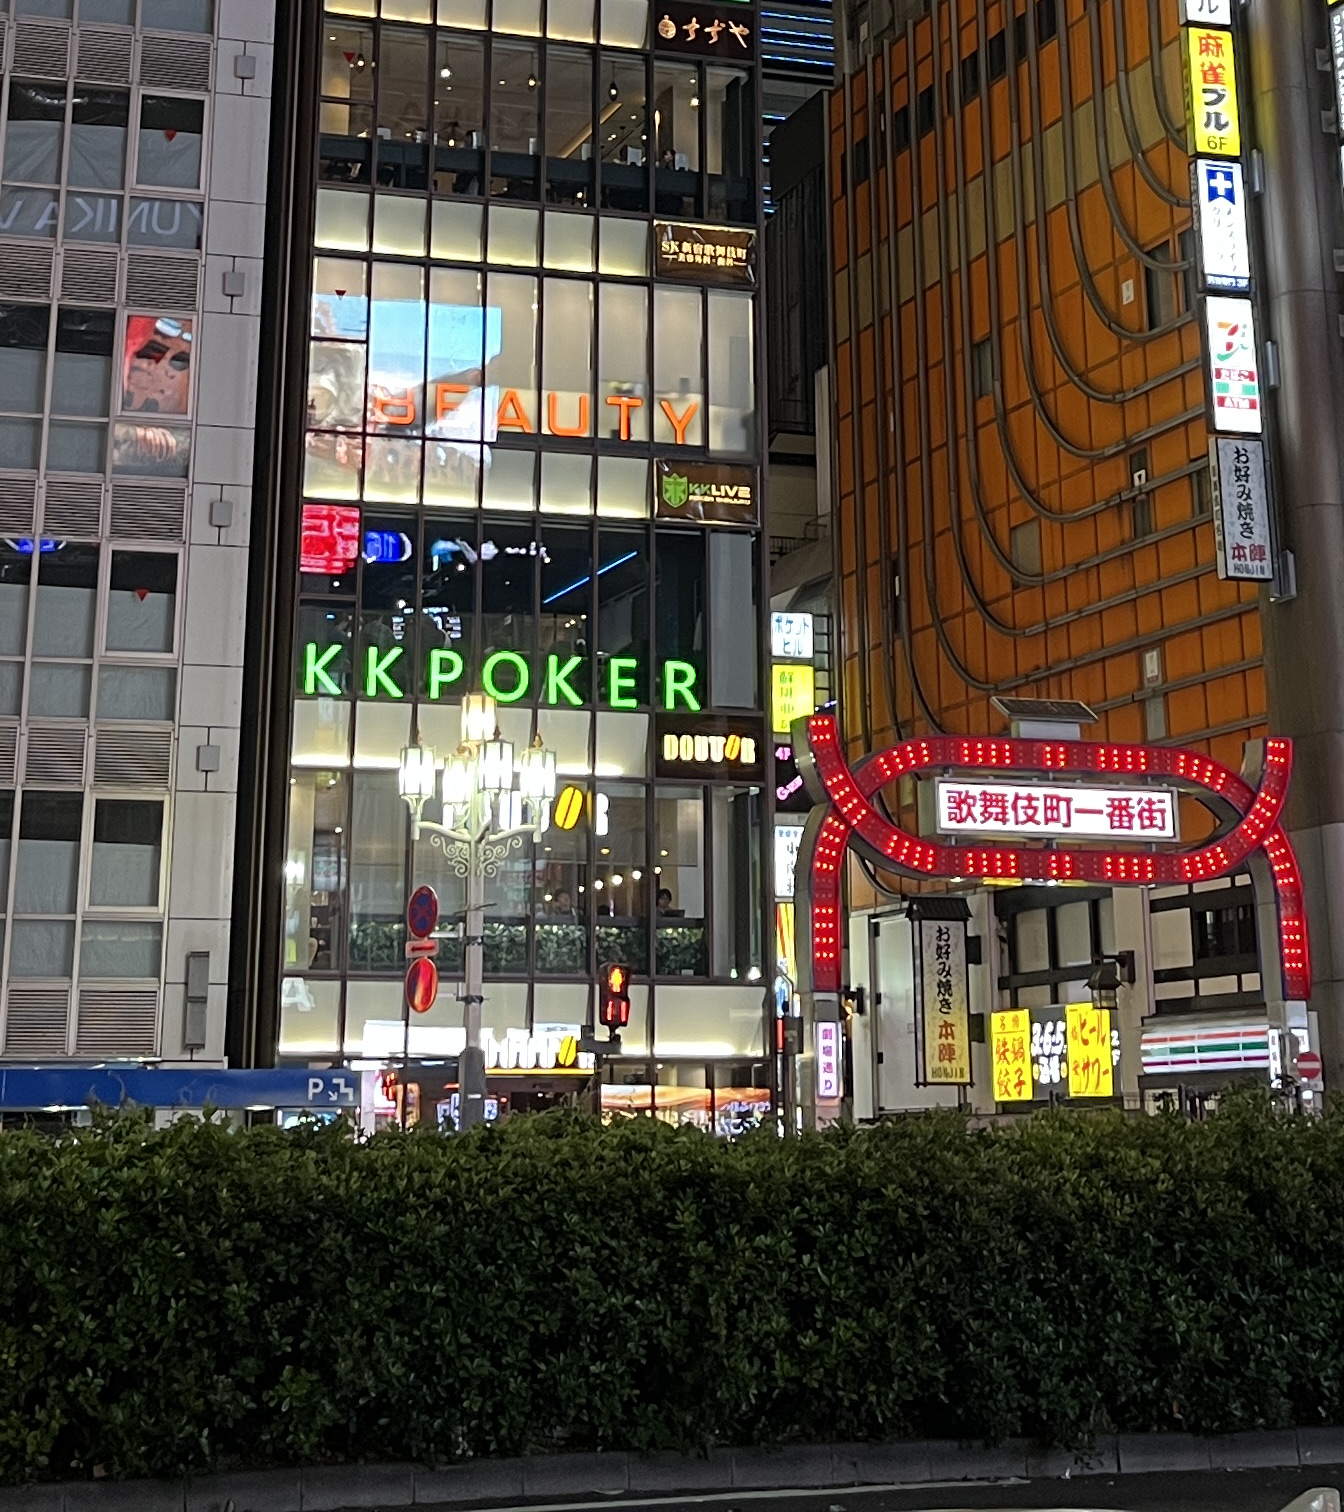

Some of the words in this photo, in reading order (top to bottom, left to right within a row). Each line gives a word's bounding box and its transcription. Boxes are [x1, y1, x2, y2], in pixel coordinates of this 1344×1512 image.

[1197, 31, 1230, 132] 麻雀ブル
[1206, 134, 1229, 153] 6F
[370, 382, 700, 446] BEAUTY
[1224, 396, 1251, 410] ATM
[1233, 446, 1256, 540] お好み焼き
[1230, 542, 1267, 563] 本陣
[303, 642, 702, 712] KKPOKER
[663, 733, 757, 766] DOUTOR
[945, 788, 1168, 832] 歌舞伎町一番街
[934, 925, 955, 1016] お好み焼き
[937, 1019, 958, 1065] 本陣
[1078, 1010, 1108, 1047] ビール
[307, 1077, 325, 1100] P
[996, 1068, 1026, 1098] 餃子
[1081, 1055, 1111, 1090] サワー
